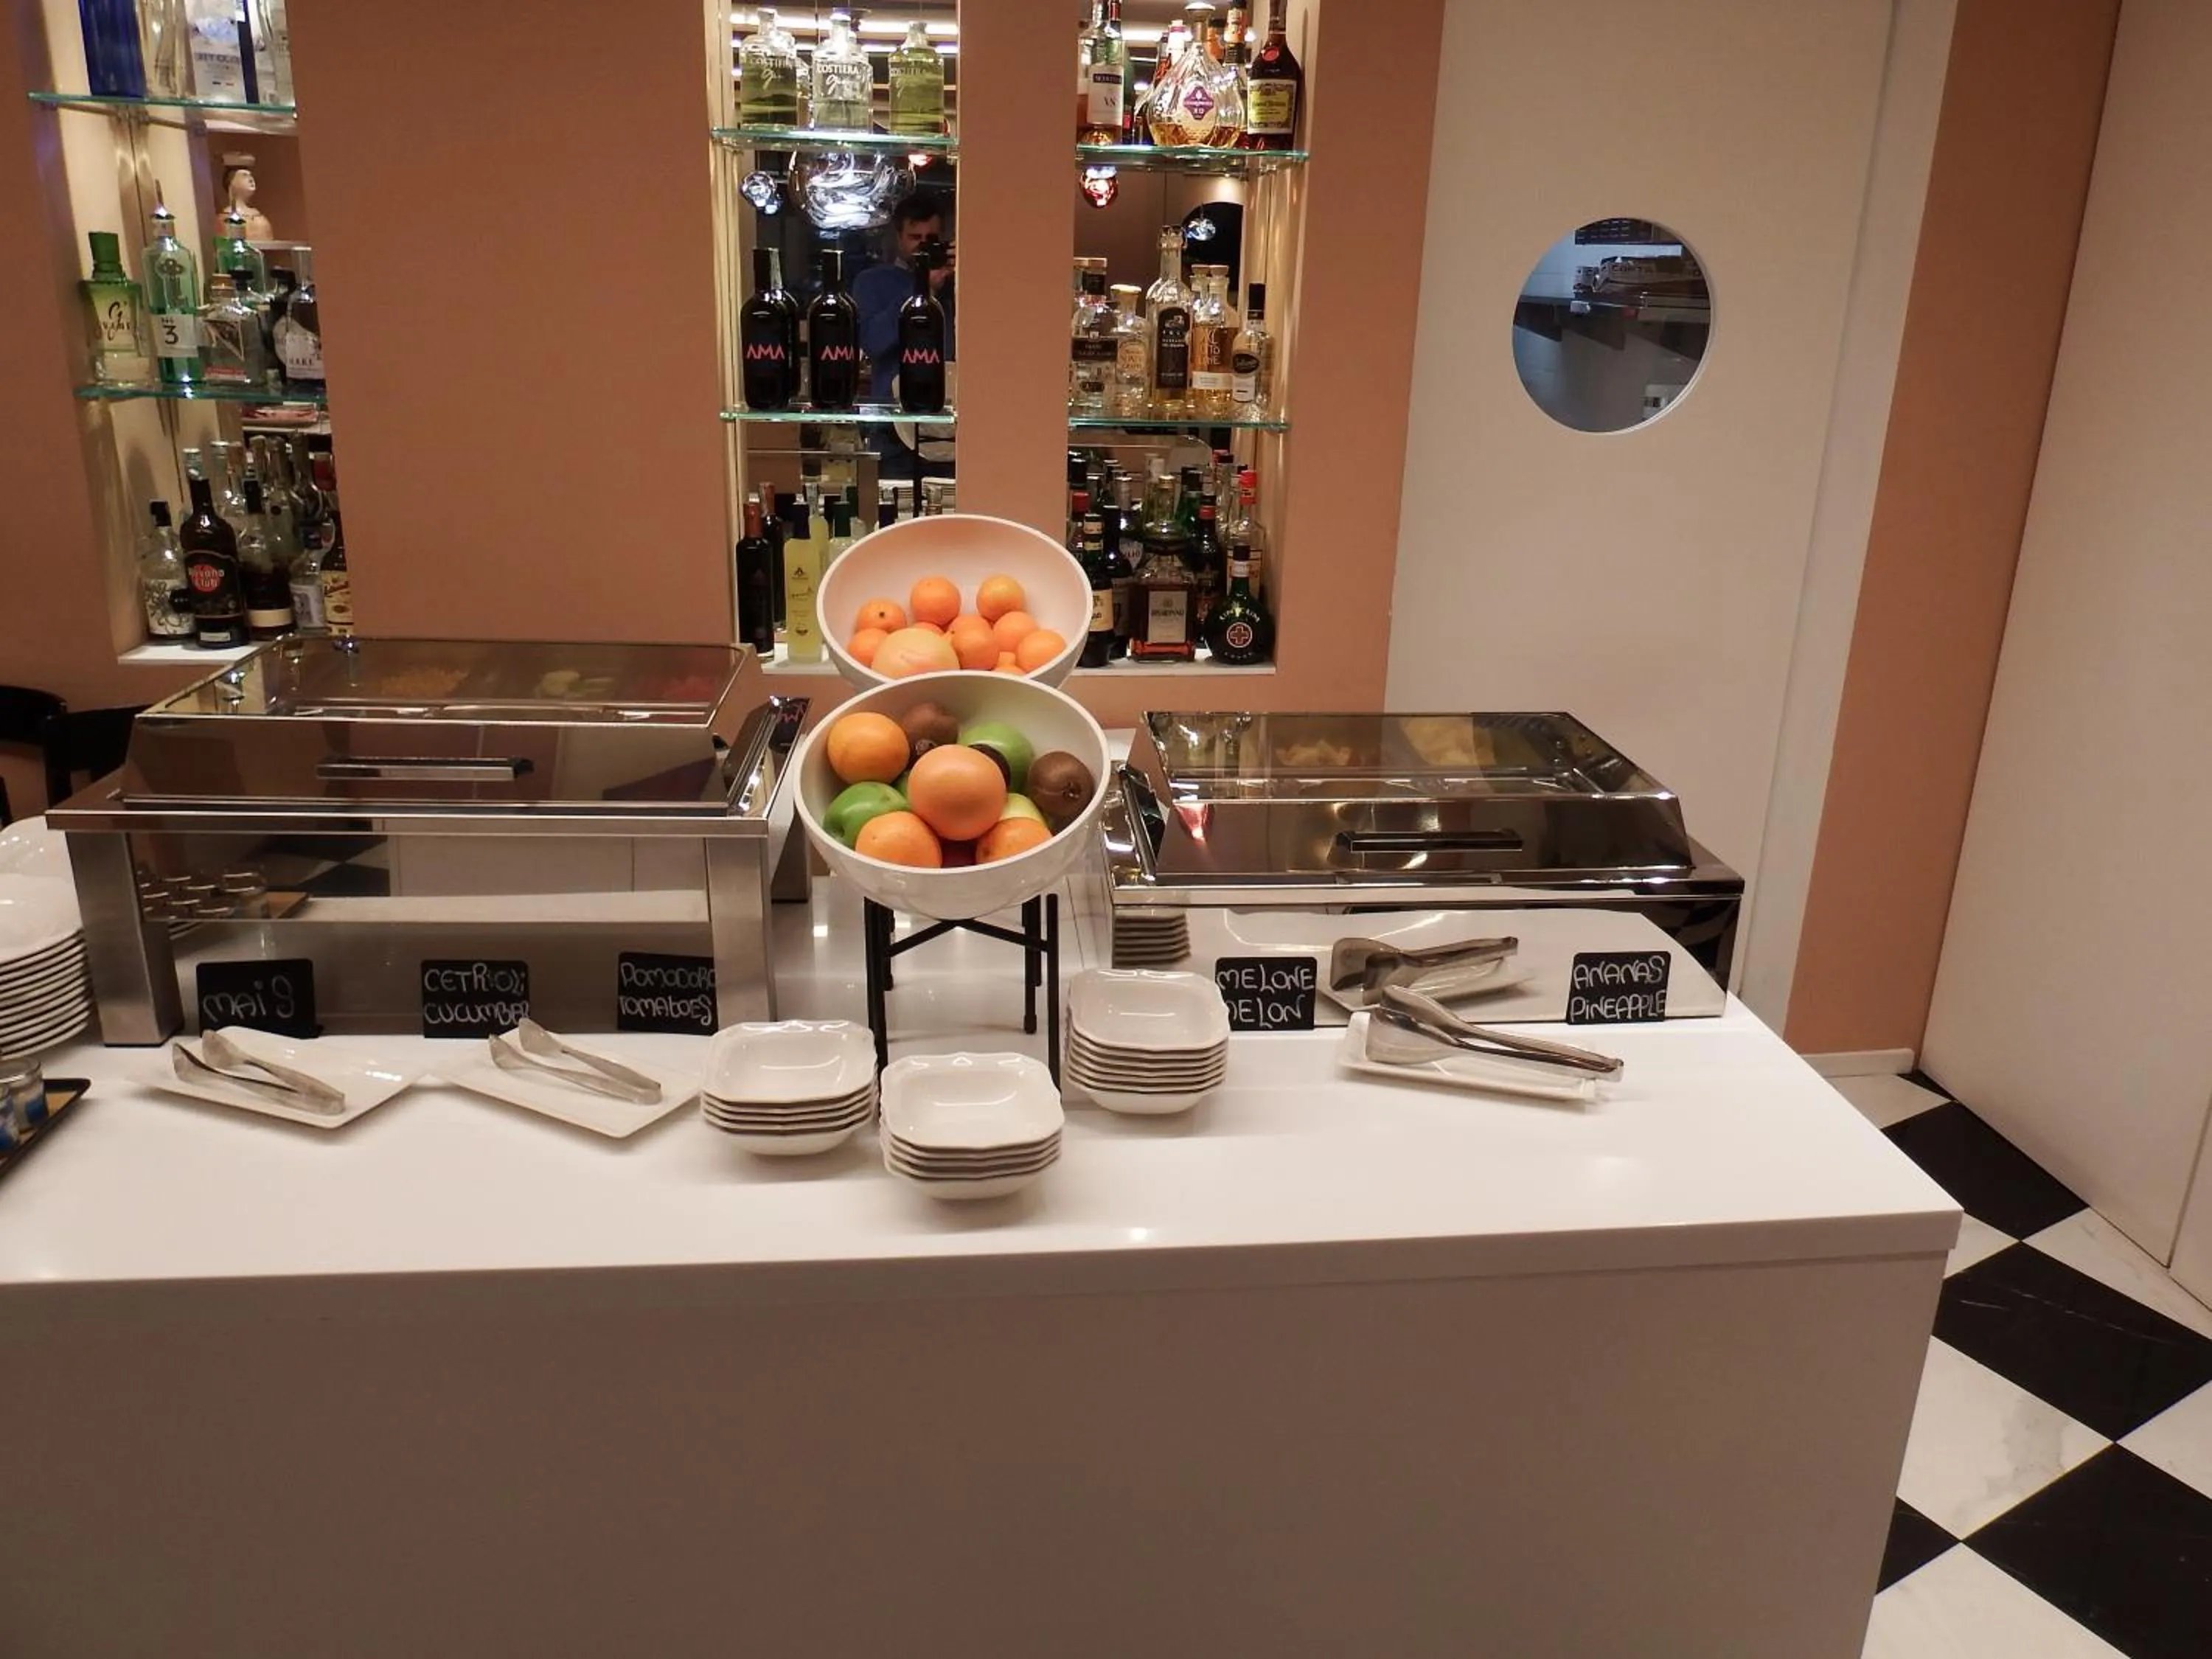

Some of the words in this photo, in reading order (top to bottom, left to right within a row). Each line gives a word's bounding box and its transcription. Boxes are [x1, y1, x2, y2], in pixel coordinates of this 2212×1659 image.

[163, 324, 179, 344] 3
[746, 344, 785, 360] AMA
[902, 348, 940, 364] AMA
[1217, 964, 1315, 994] MELONE
[1573, 955, 1666, 990] ANANAS
